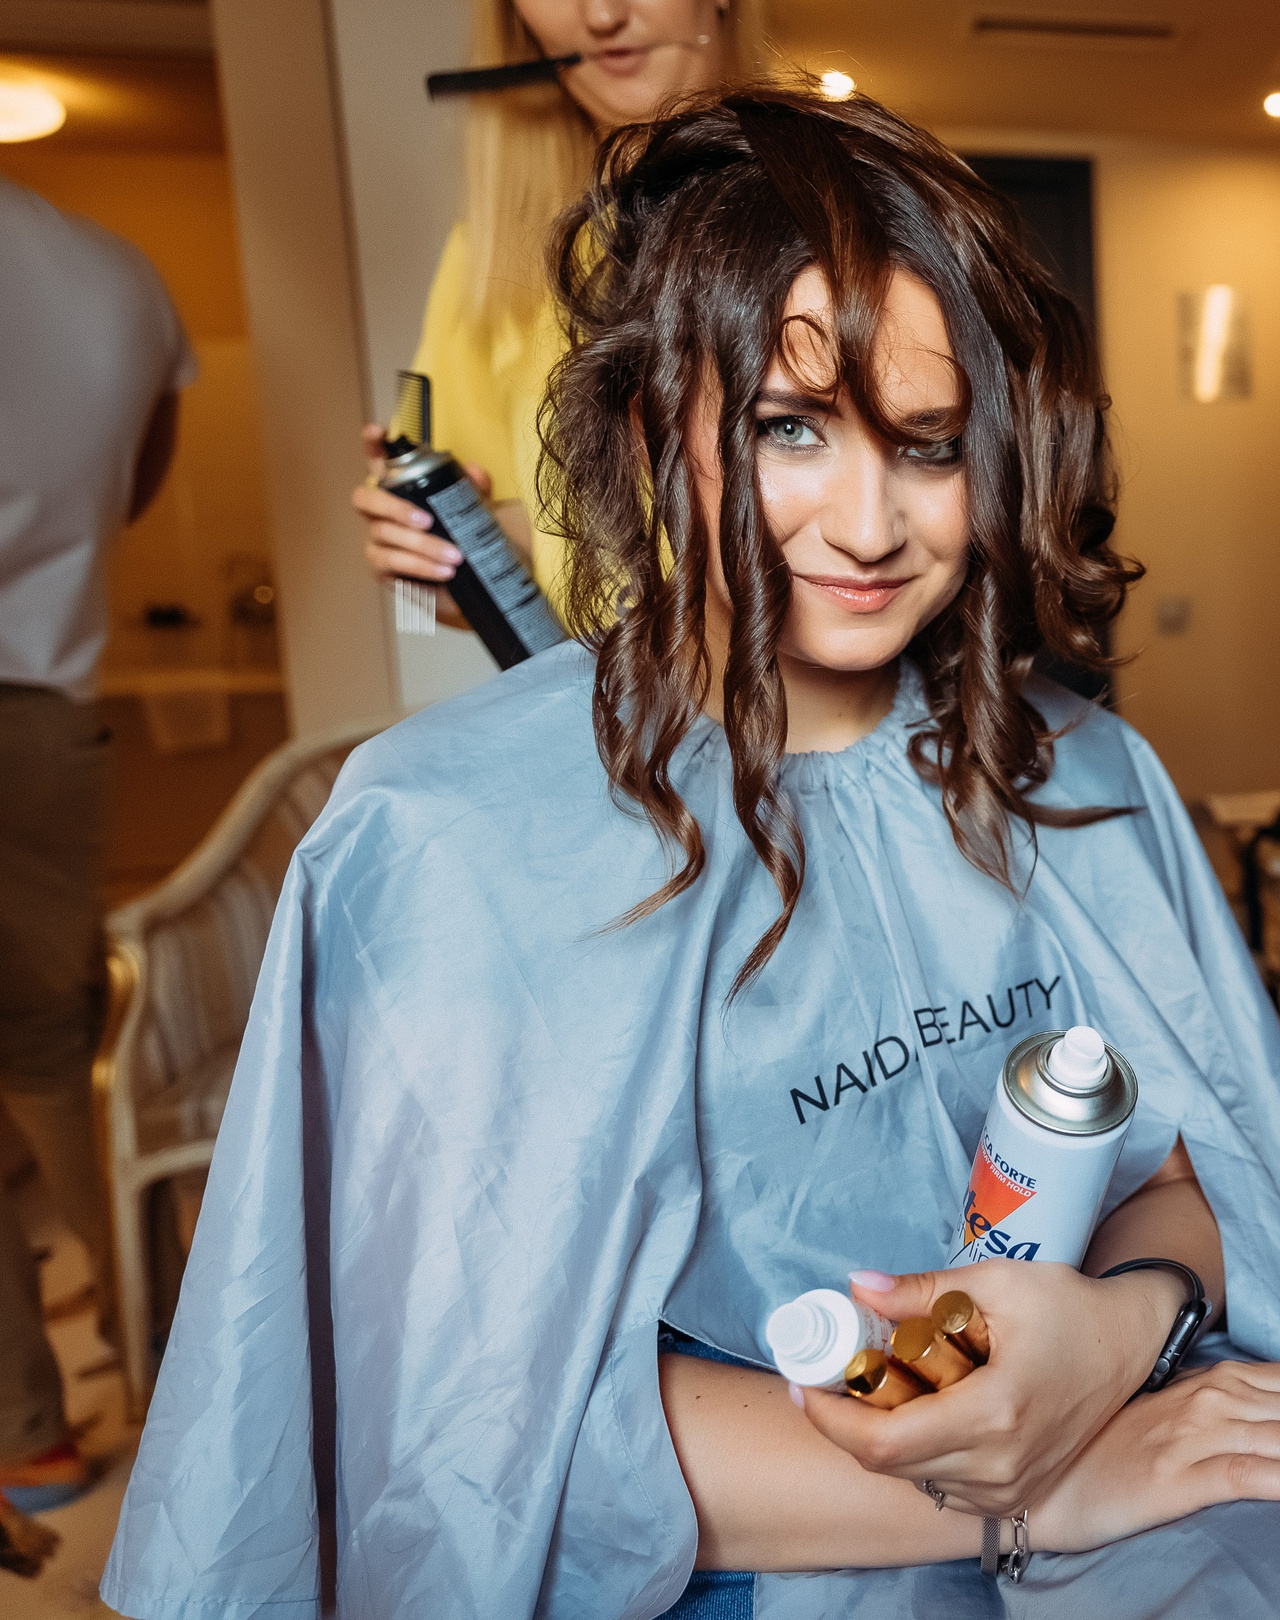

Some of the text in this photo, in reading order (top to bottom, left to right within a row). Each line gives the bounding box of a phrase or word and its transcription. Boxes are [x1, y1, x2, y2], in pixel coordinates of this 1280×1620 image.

[789, 975, 1062, 1125] NAID BEAUTY
[989, 1164, 1007, 1184] FIRM
[1006, 1180, 1032, 1198] HOLD
[993, 1152, 1037, 1189] FORTE
[963, 1182, 1042, 1262] tesa
